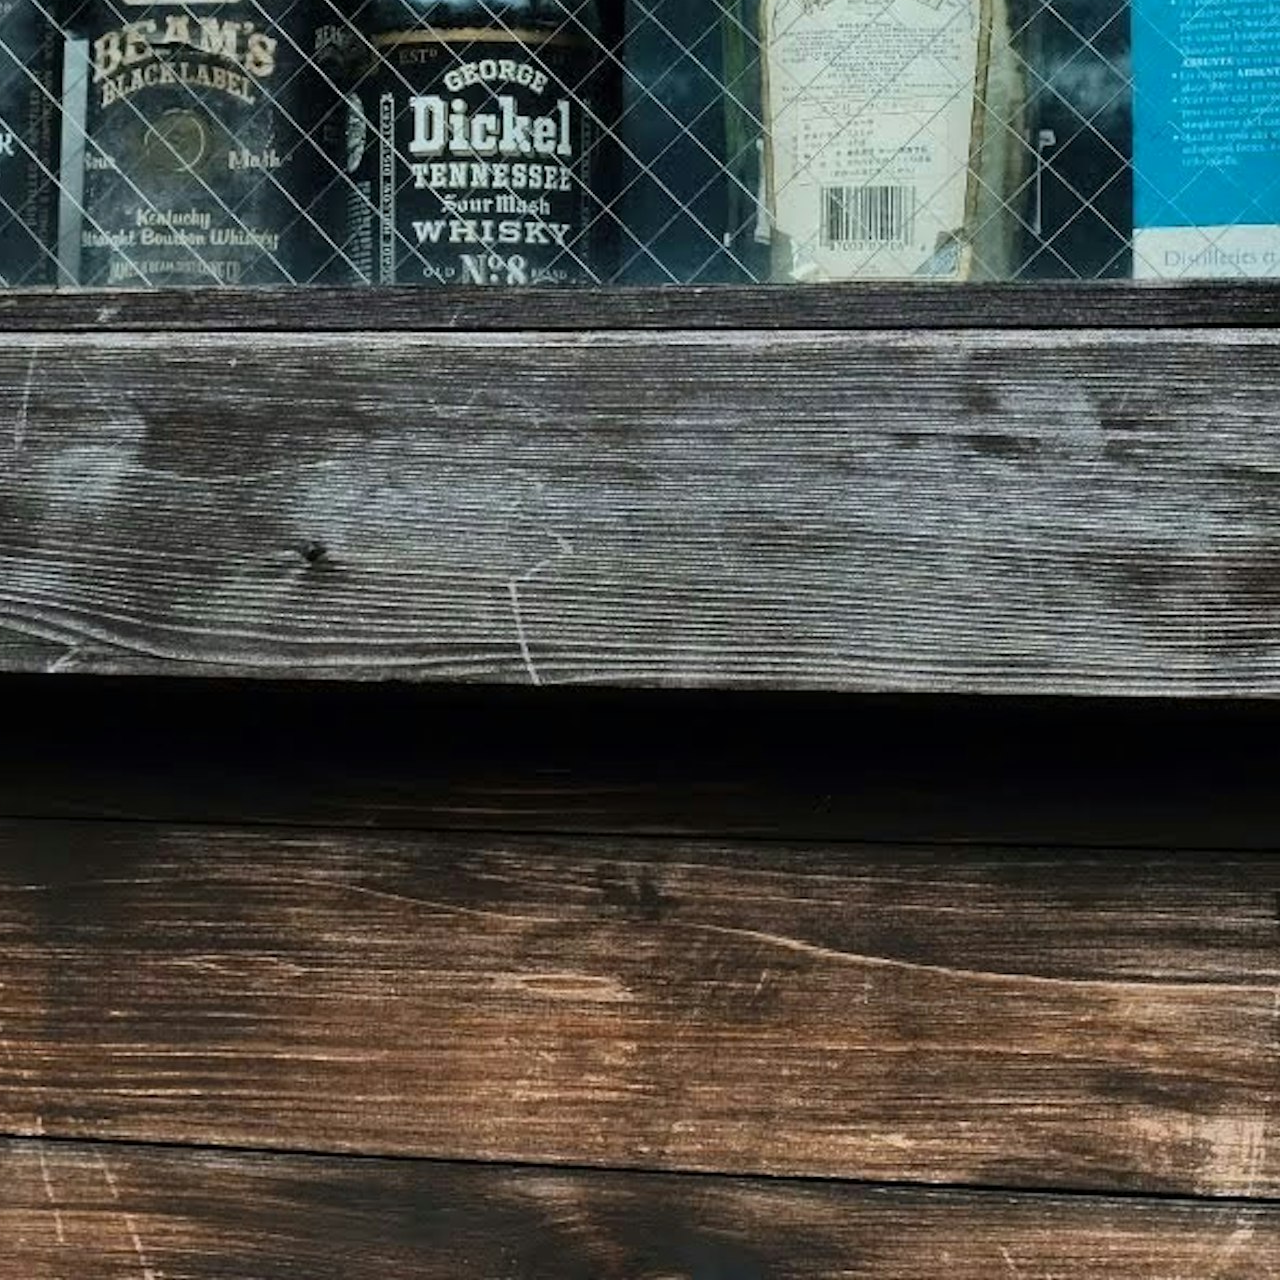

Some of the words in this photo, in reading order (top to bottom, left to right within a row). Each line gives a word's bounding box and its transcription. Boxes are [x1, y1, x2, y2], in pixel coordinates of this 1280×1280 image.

[93, 14, 279, 83] BEAM'S
[101, 61, 172, 108] BLACK
[181, 61, 256, 106] LABEL
[443, 59, 549, 95] GEORGE
[409, 95, 573, 157] Dickel
[410, 162, 572, 191] TENNESSEE
[135, 207, 211, 229] Kentucky
[440, 193, 494, 215] Sour
[495, 193, 550, 216] Mash
[411, 220, 571, 244] WHISKY
[422, 267, 456, 279] OLD
